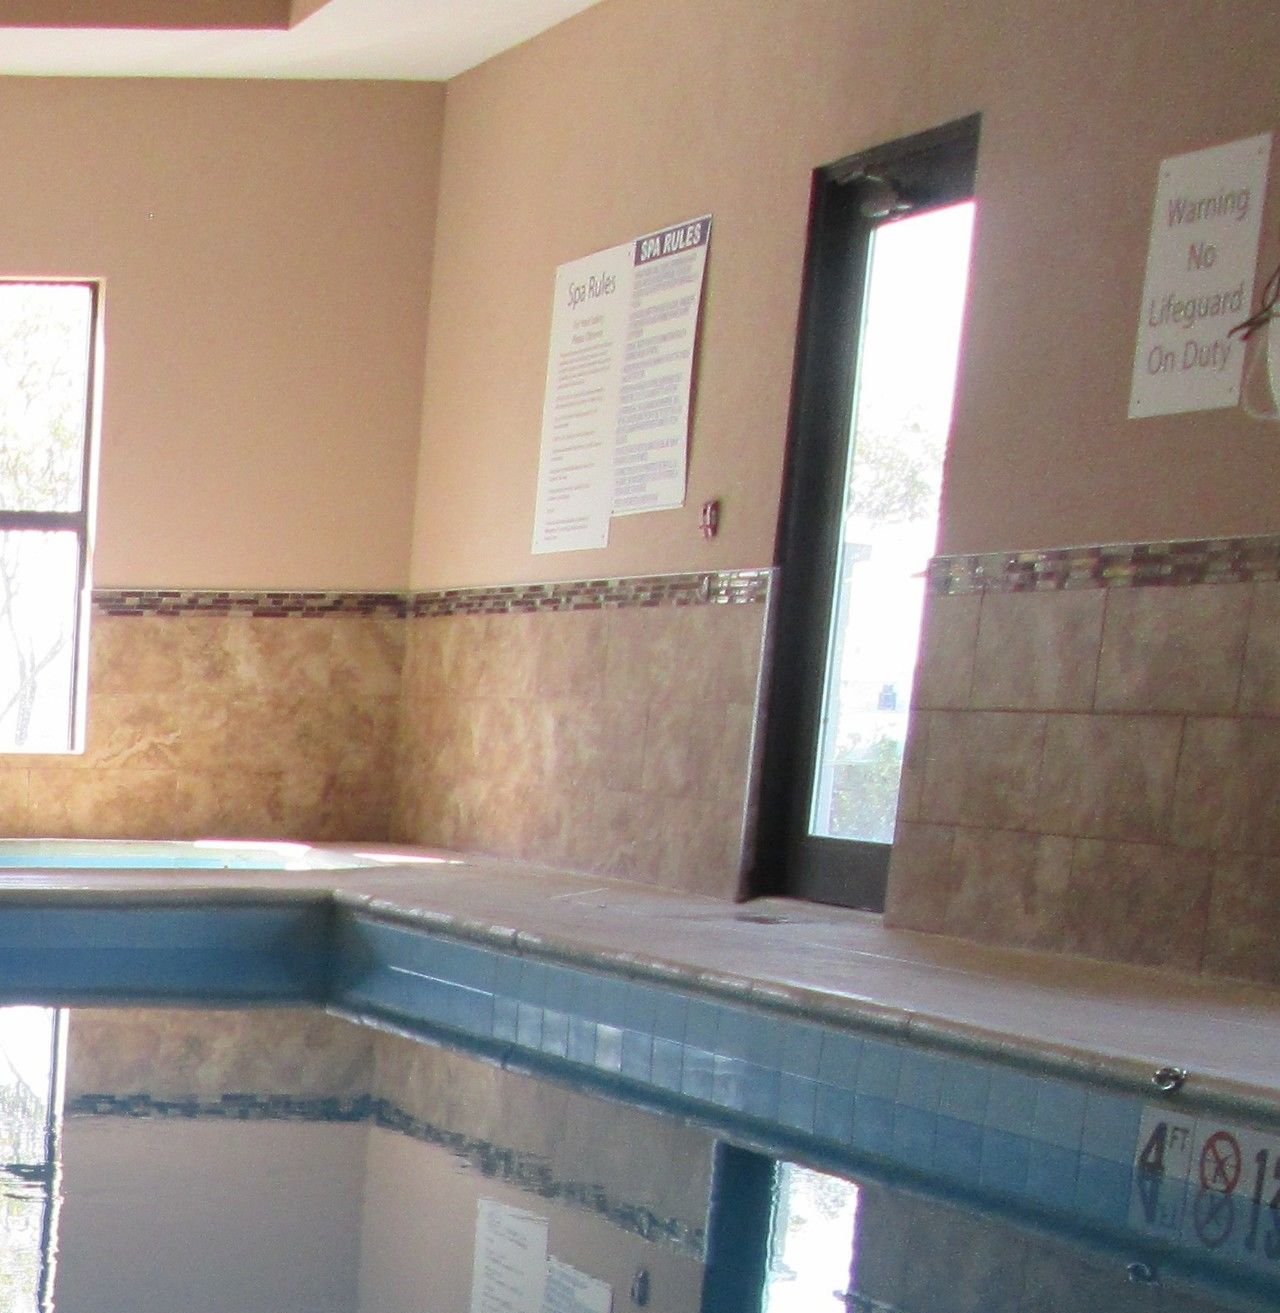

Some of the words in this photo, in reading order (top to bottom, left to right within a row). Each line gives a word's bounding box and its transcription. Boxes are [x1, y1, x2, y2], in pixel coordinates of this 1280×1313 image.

[1167, 187, 1251, 230] Warning
[640, 238, 661, 261] SPA
[663, 224, 702, 254] RULES
[1188, 241, 1218, 271] No
[567, 282, 587, 310] Spa
[588, 272, 616, 299] Rules
[1148, 283, 1244, 329] Lifeguard
[1147, 345, 1175, 376] On
[1183, 339, 1232, 372] Duty
[1137, 1121, 1168, 1175] 4
[1170, 1127, 1190, 1152] FT
